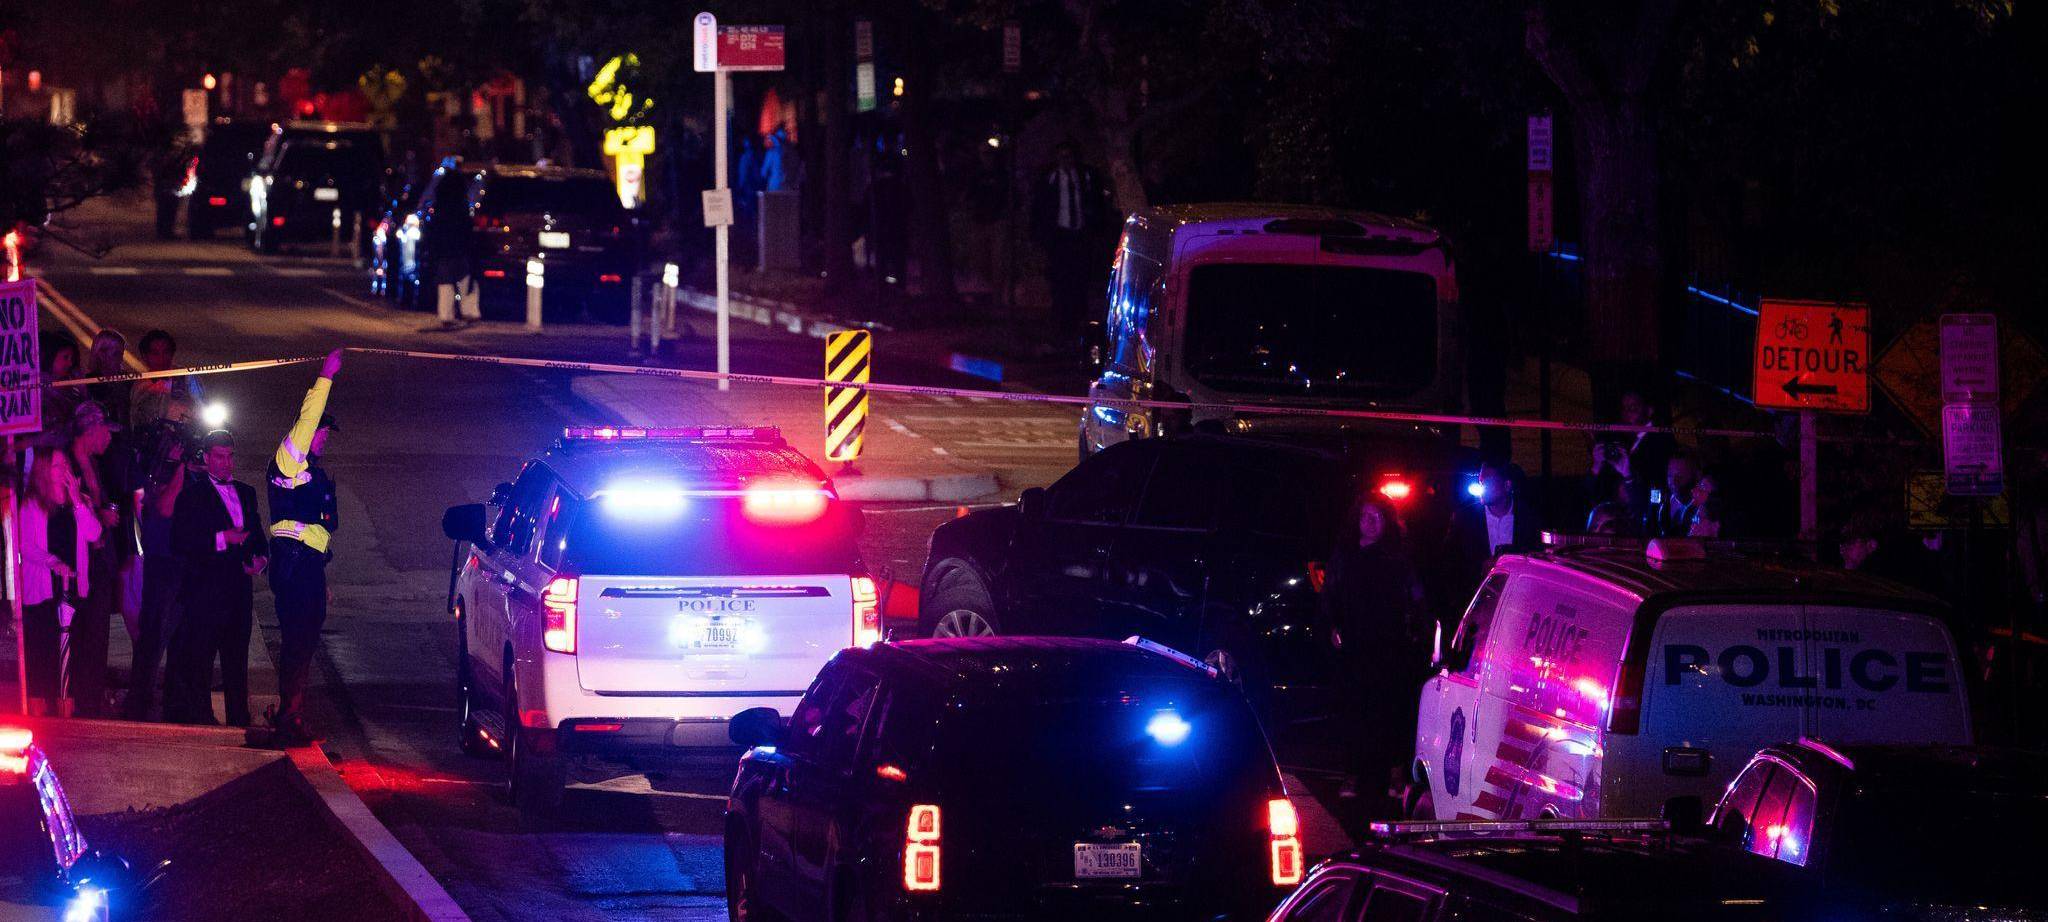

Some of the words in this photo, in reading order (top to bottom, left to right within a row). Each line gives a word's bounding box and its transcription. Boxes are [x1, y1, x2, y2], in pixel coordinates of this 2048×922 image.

[1762, 346, 1865, 374] DETOUR
[679, 599, 756, 612] POLICE
[1523, 612, 1589, 663] POLICE
[1756, 628, 1860, 642] METROPOLITAN
[1664, 644, 1950, 694] POLICE
[1856, 698, 1876, 711] DC
[1098, 852, 1135, 868] 130396
